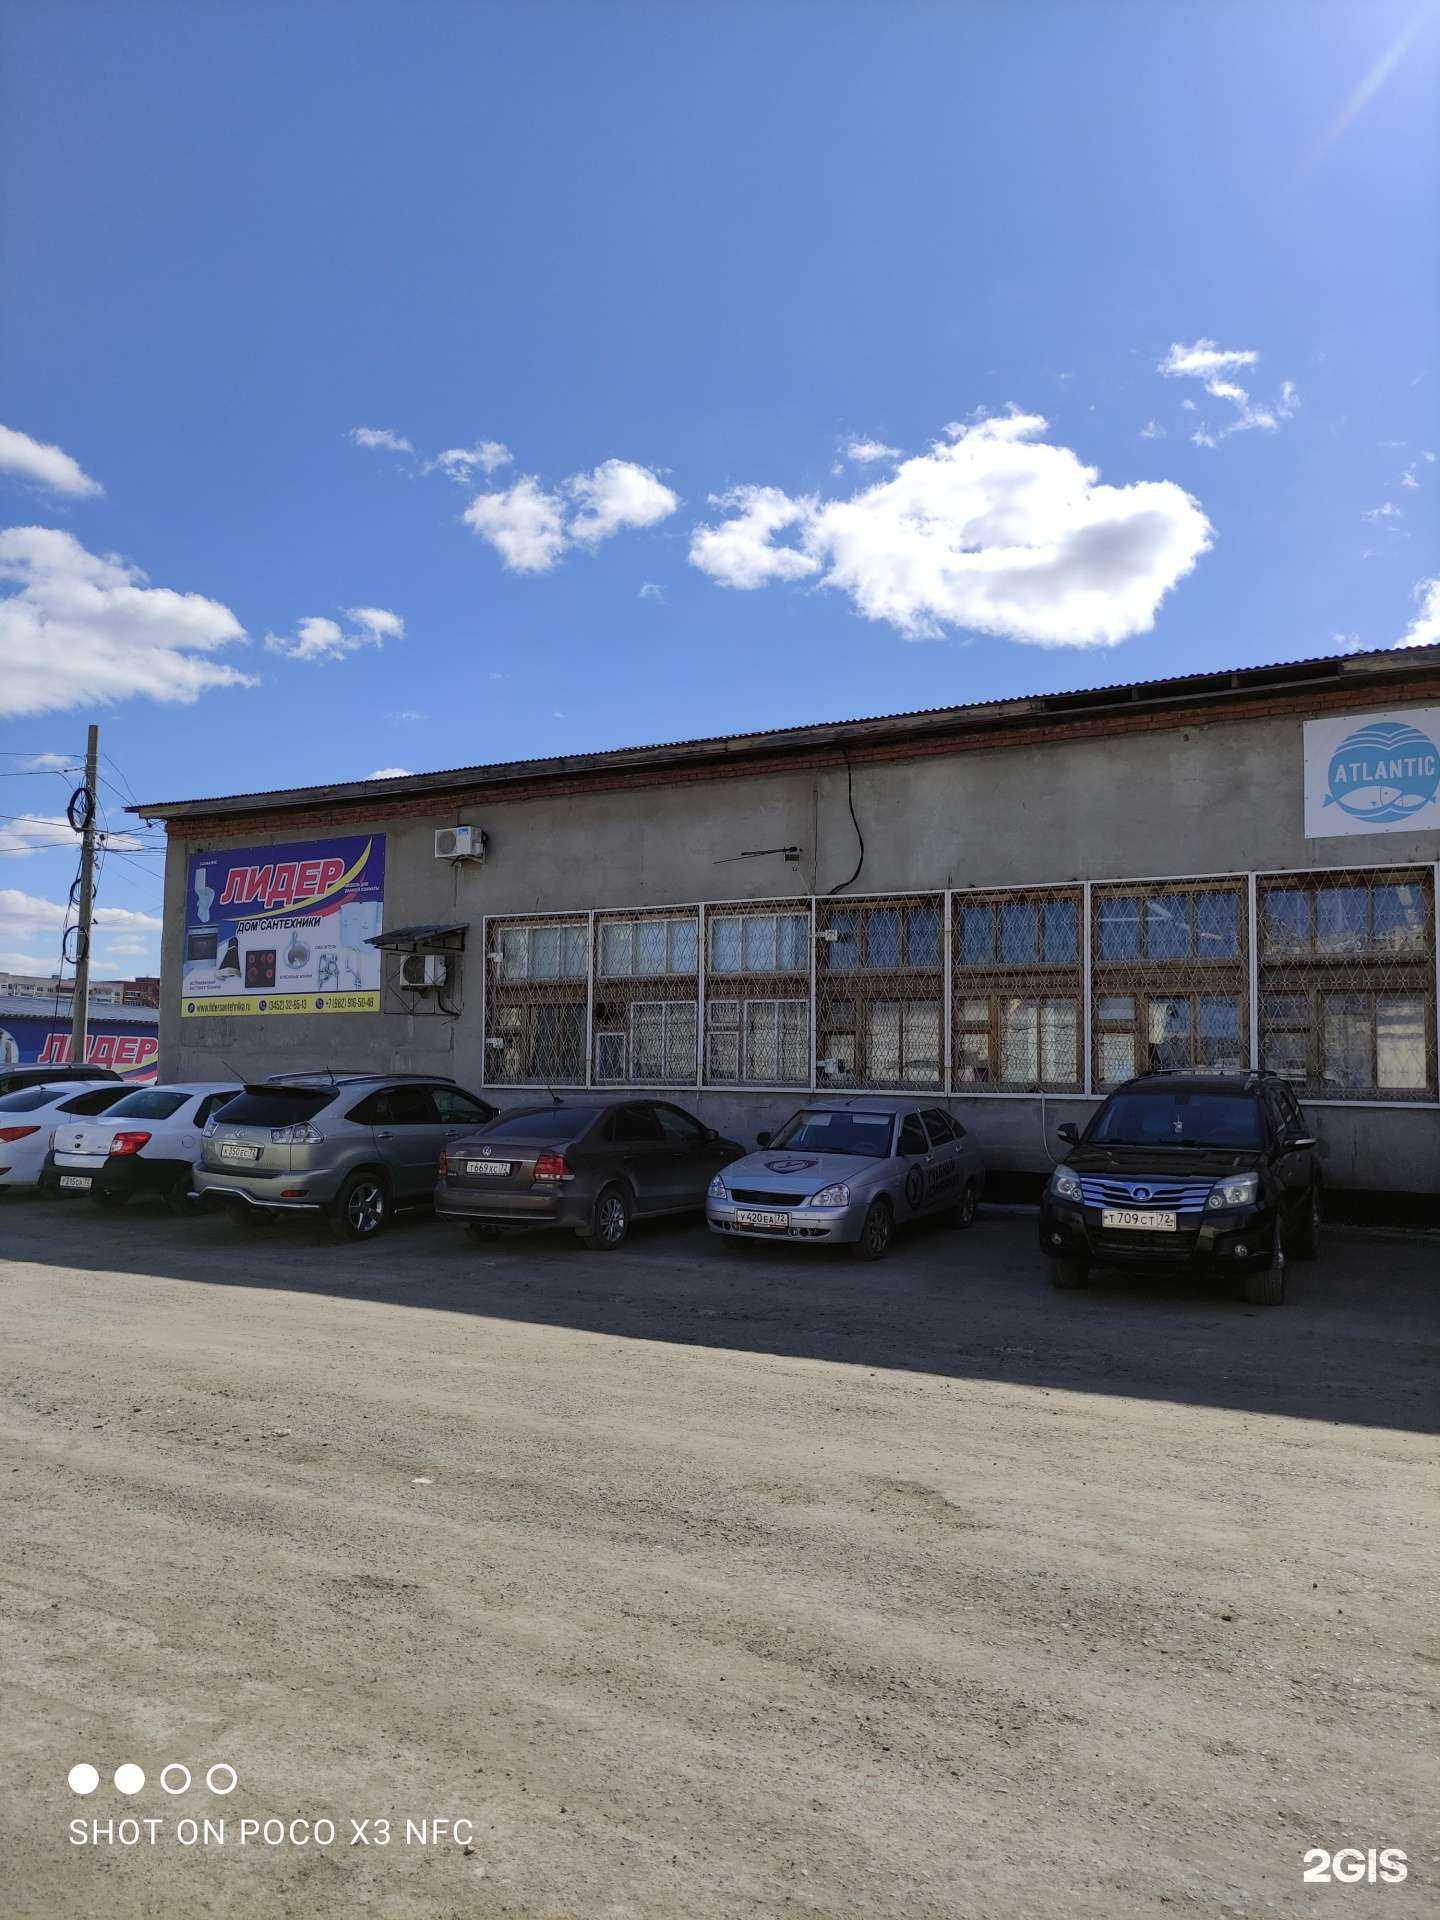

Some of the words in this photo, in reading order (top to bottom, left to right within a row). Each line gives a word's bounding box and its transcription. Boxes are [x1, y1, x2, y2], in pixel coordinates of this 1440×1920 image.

[1334, 755, 1436, 783] ATLANTIC
[220, 858, 346, 909] ЛИДЕР
[236, 919, 260, 935] ДОМ
[260, 916, 321, 931] САНТЕХНИКИ
